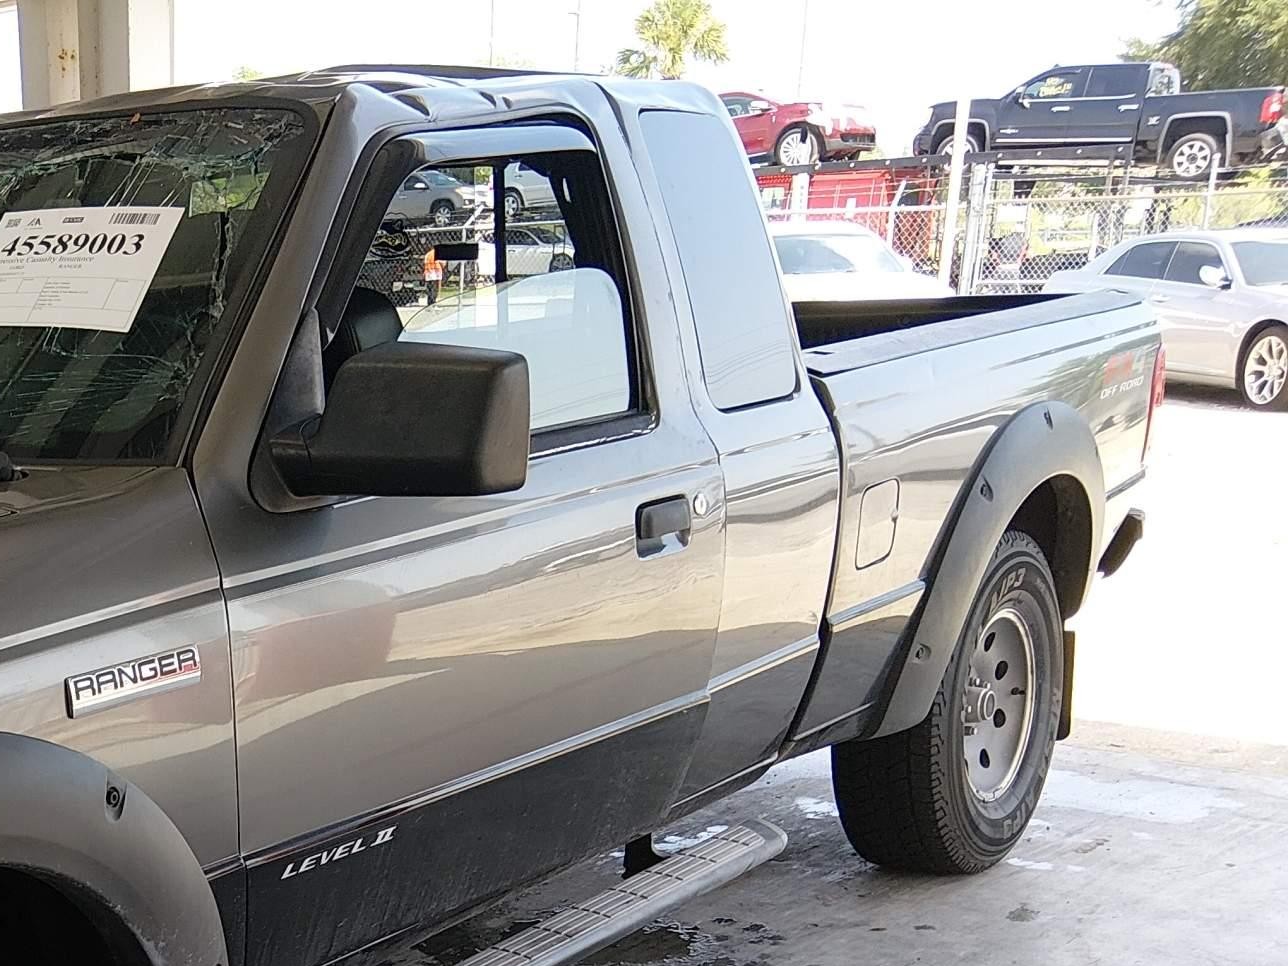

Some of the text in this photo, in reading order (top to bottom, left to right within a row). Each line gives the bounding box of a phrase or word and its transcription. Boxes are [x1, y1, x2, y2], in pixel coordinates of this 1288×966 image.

[1, 233, 145, 257] 45589003
[1100, 375, 1145, 400] OFF ROAD
[73, 648, 198, 700] RANGER
[280, 825, 398, 880] LEVEL II
